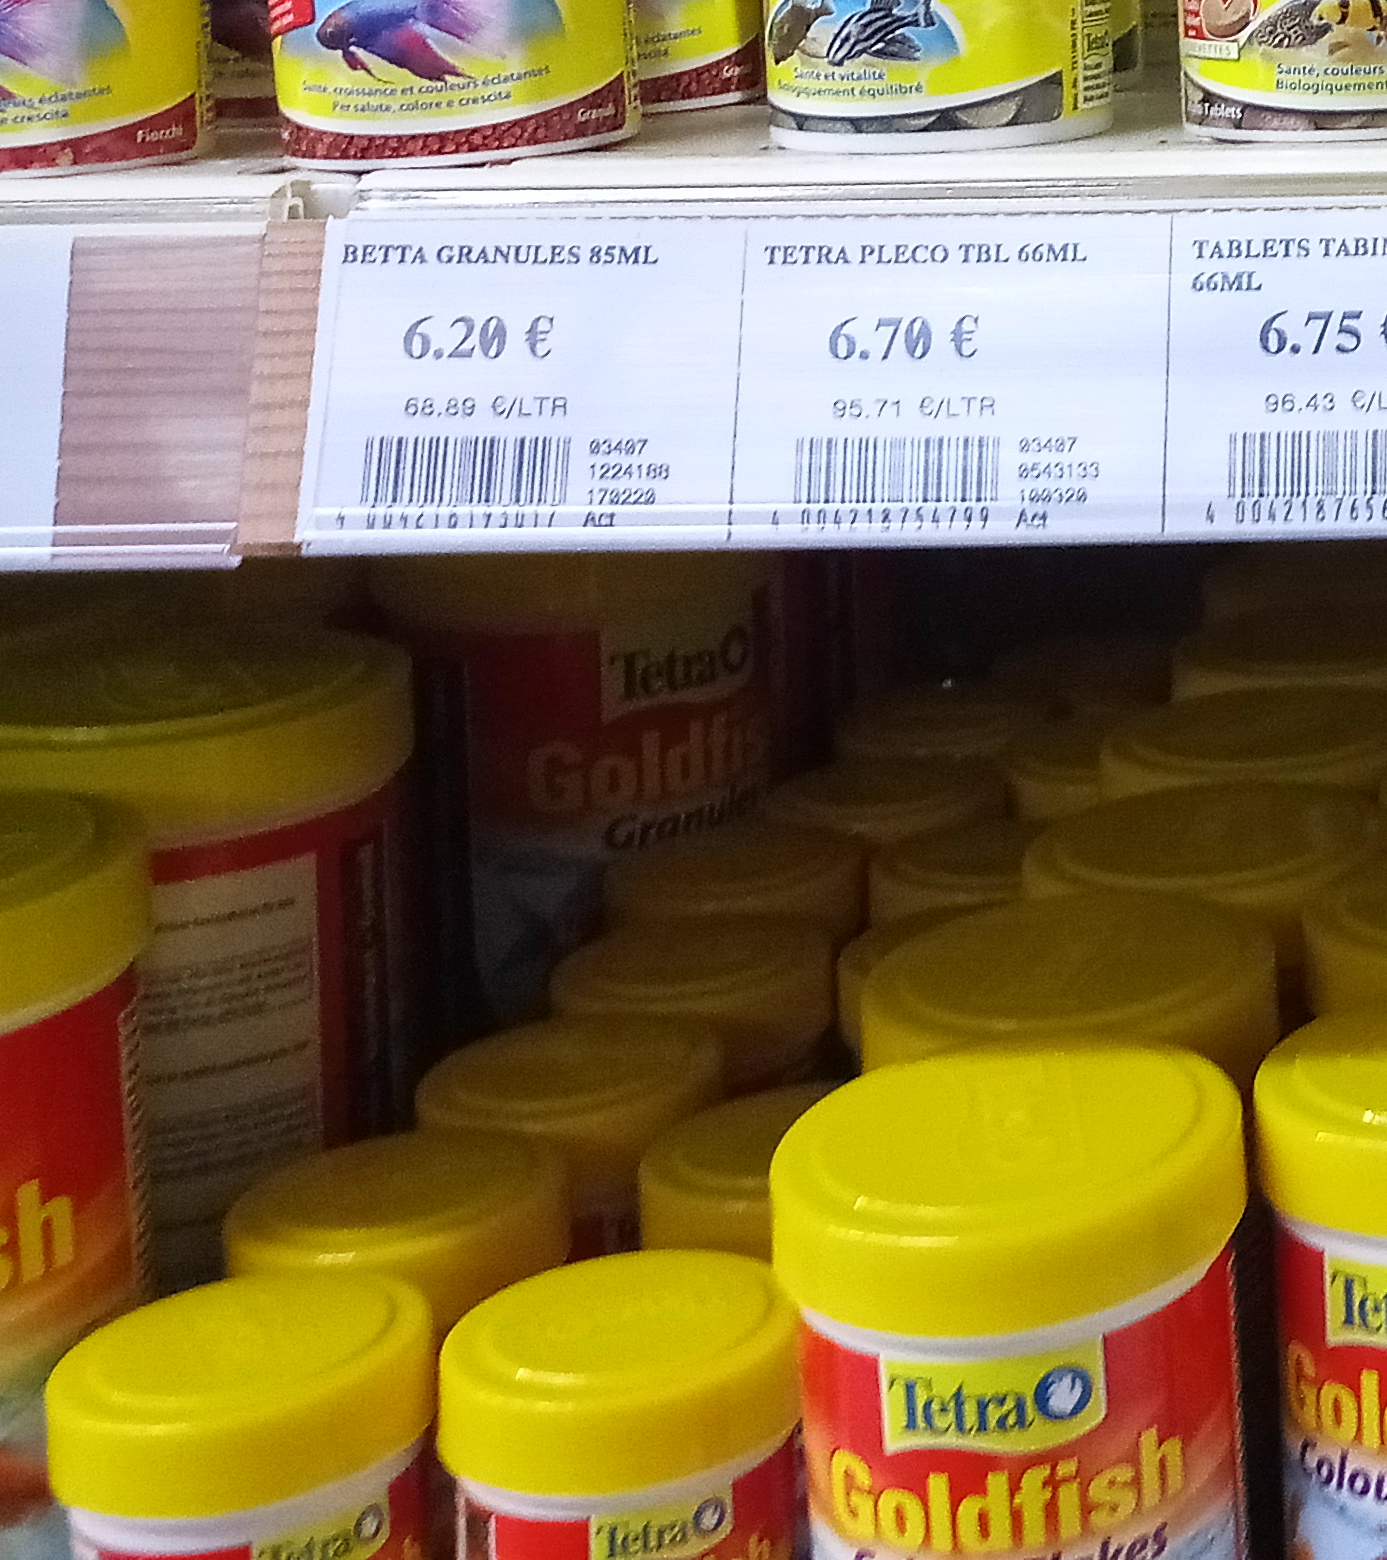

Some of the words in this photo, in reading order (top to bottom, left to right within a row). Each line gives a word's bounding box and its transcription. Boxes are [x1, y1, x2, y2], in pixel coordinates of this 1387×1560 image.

[342, 243, 428, 265] BETTA
[436, 243, 581, 265] GRANULES
[589, 244, 659, 266] 85ML
[764, 243, 849, 266] TETRA
[858, 243, 949, 265] PLECO
[959, 243, 1010, 264] TBL
[1017, 242, 1088, 263] 66ML
[1192, 237, 1311, 260] TABLETS
[1191, 270, 1263, 293] 66ML
[402, 315, 507, 361] 6.20
[524, 315, 555, 360] €
[828, 315, 933, 362] 6.70
[949, 313, 980, 359] €
[1258, 309, 1364, 357] 6.75
[491, 395, 568, 420] €/LTR
[832, 398, 902, 420] 95.71
[918, 396, 996, 420] €/LTR
[1264, 392, 1337, 413] 96.43
[589, 438, 649, 455] 03407
[1019, 436, 1079, 453] 03407
[1017, 462, 1100, 481] 0543133
[609, 649, 718, 702] Tetra
[887, 1375, 1036, 1438] Tetra
[830, 1424, 1186, 1554] Goldfish
